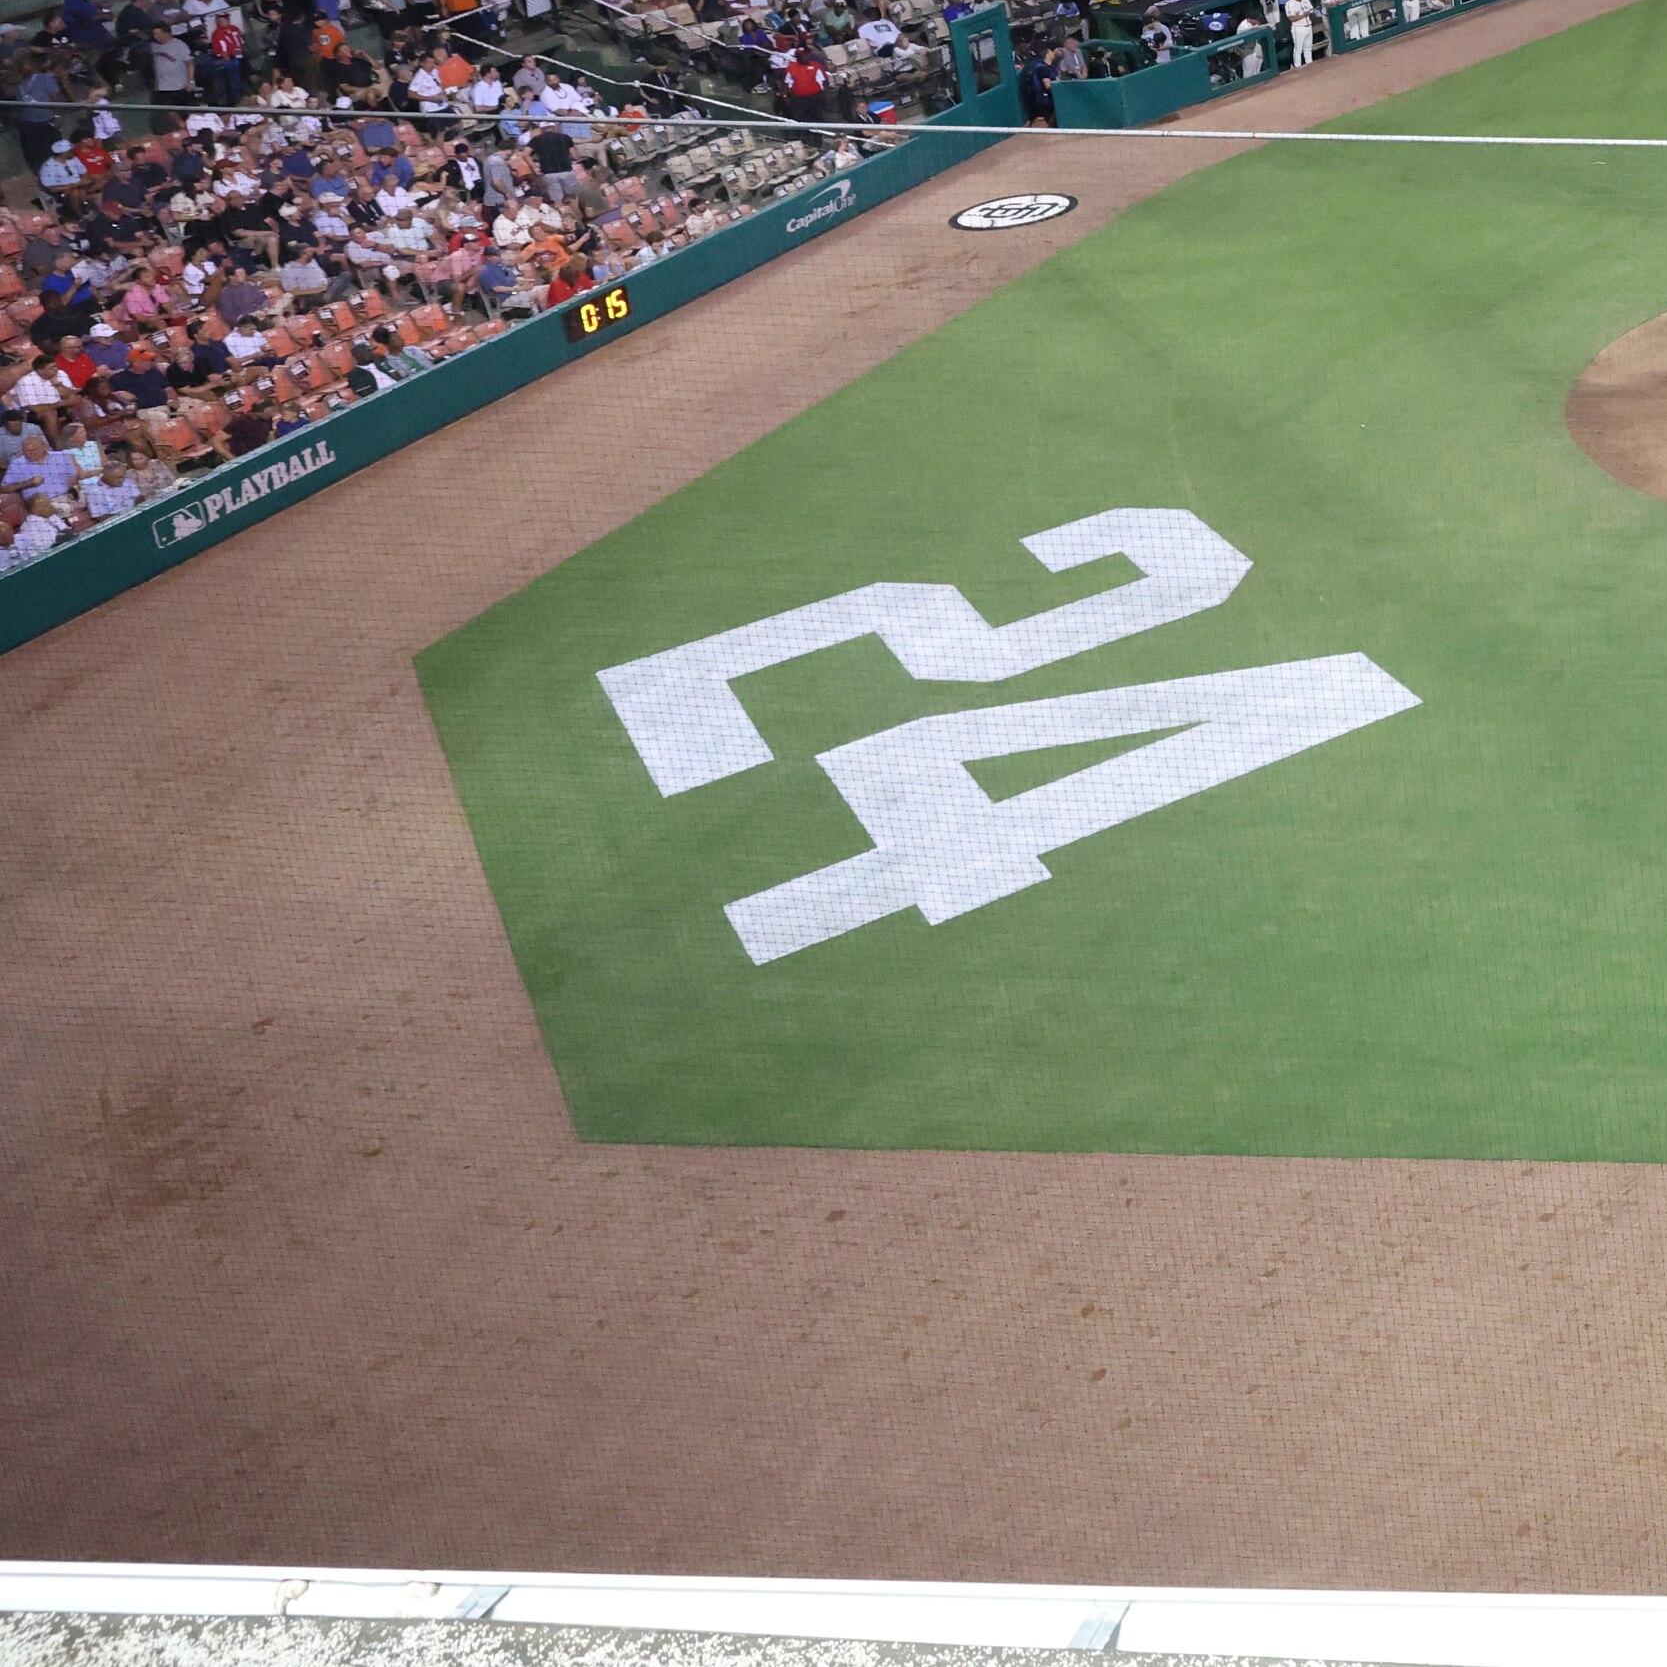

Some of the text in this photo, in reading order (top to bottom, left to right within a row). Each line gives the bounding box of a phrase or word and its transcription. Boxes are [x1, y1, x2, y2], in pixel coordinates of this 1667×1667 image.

[581, 289, 627, 333] 0:15
[203, 440, 336, 523] PLAYBALL
[595, 507, 1424, 966] 24
